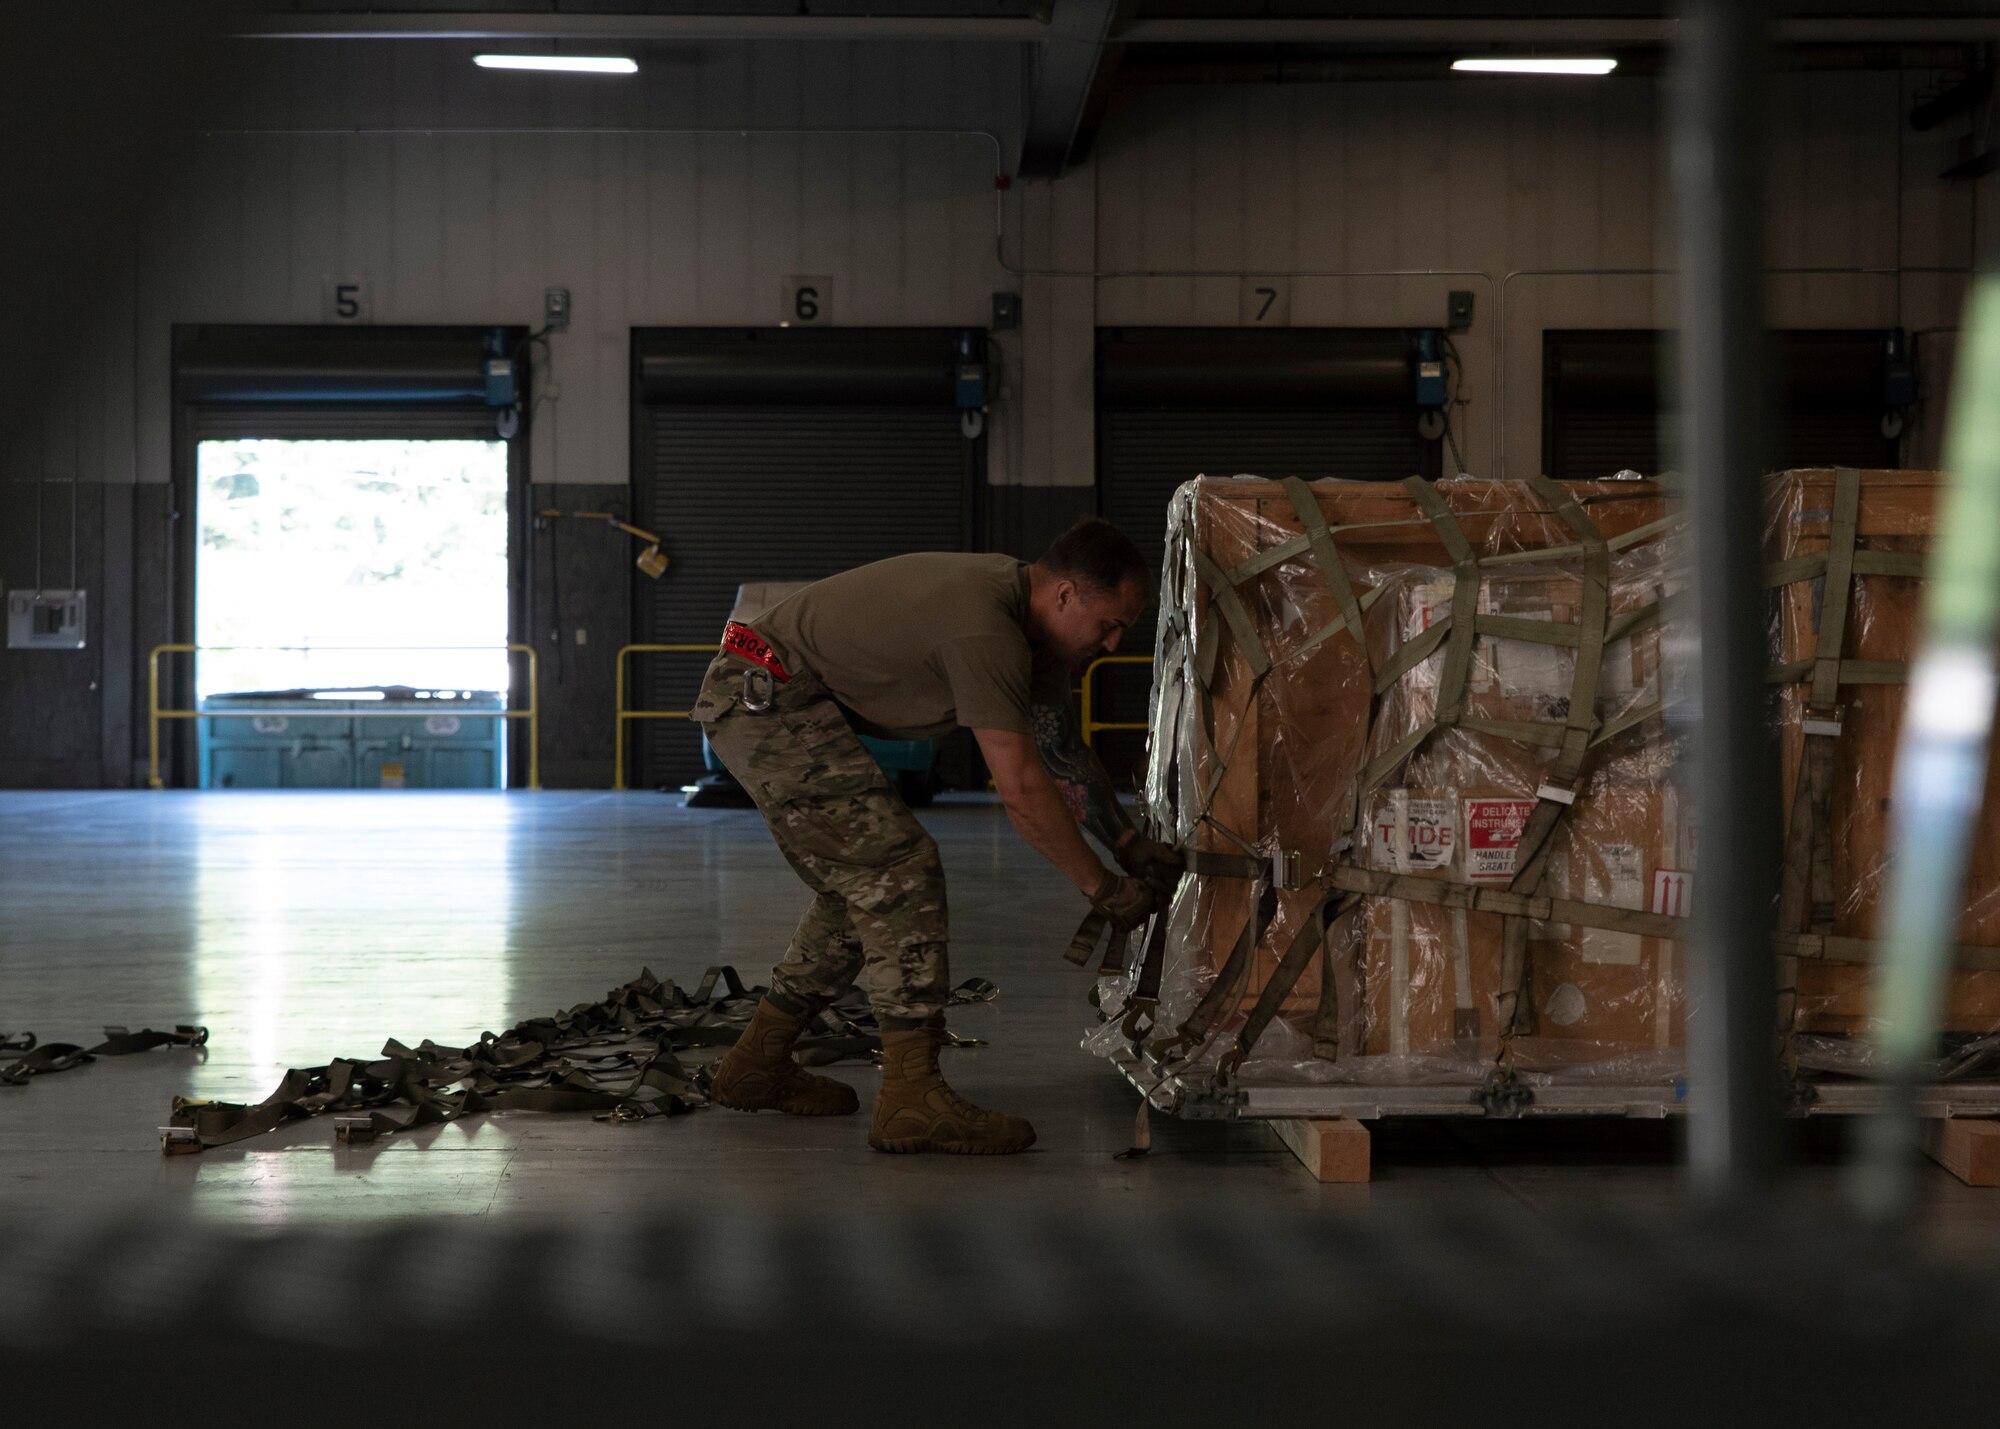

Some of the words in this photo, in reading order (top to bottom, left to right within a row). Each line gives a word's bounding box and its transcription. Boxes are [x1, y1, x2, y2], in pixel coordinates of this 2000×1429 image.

[336, 286, 359, 318] 5
[796, 287, 818, 320] 6
[1255, 288, 1276, 321] 7
[1482, 806, 1531, 817] DELICATE
[1476, 851, 1512, 860] HANDLE
[1480, 862, 1509, 871] GREAT
